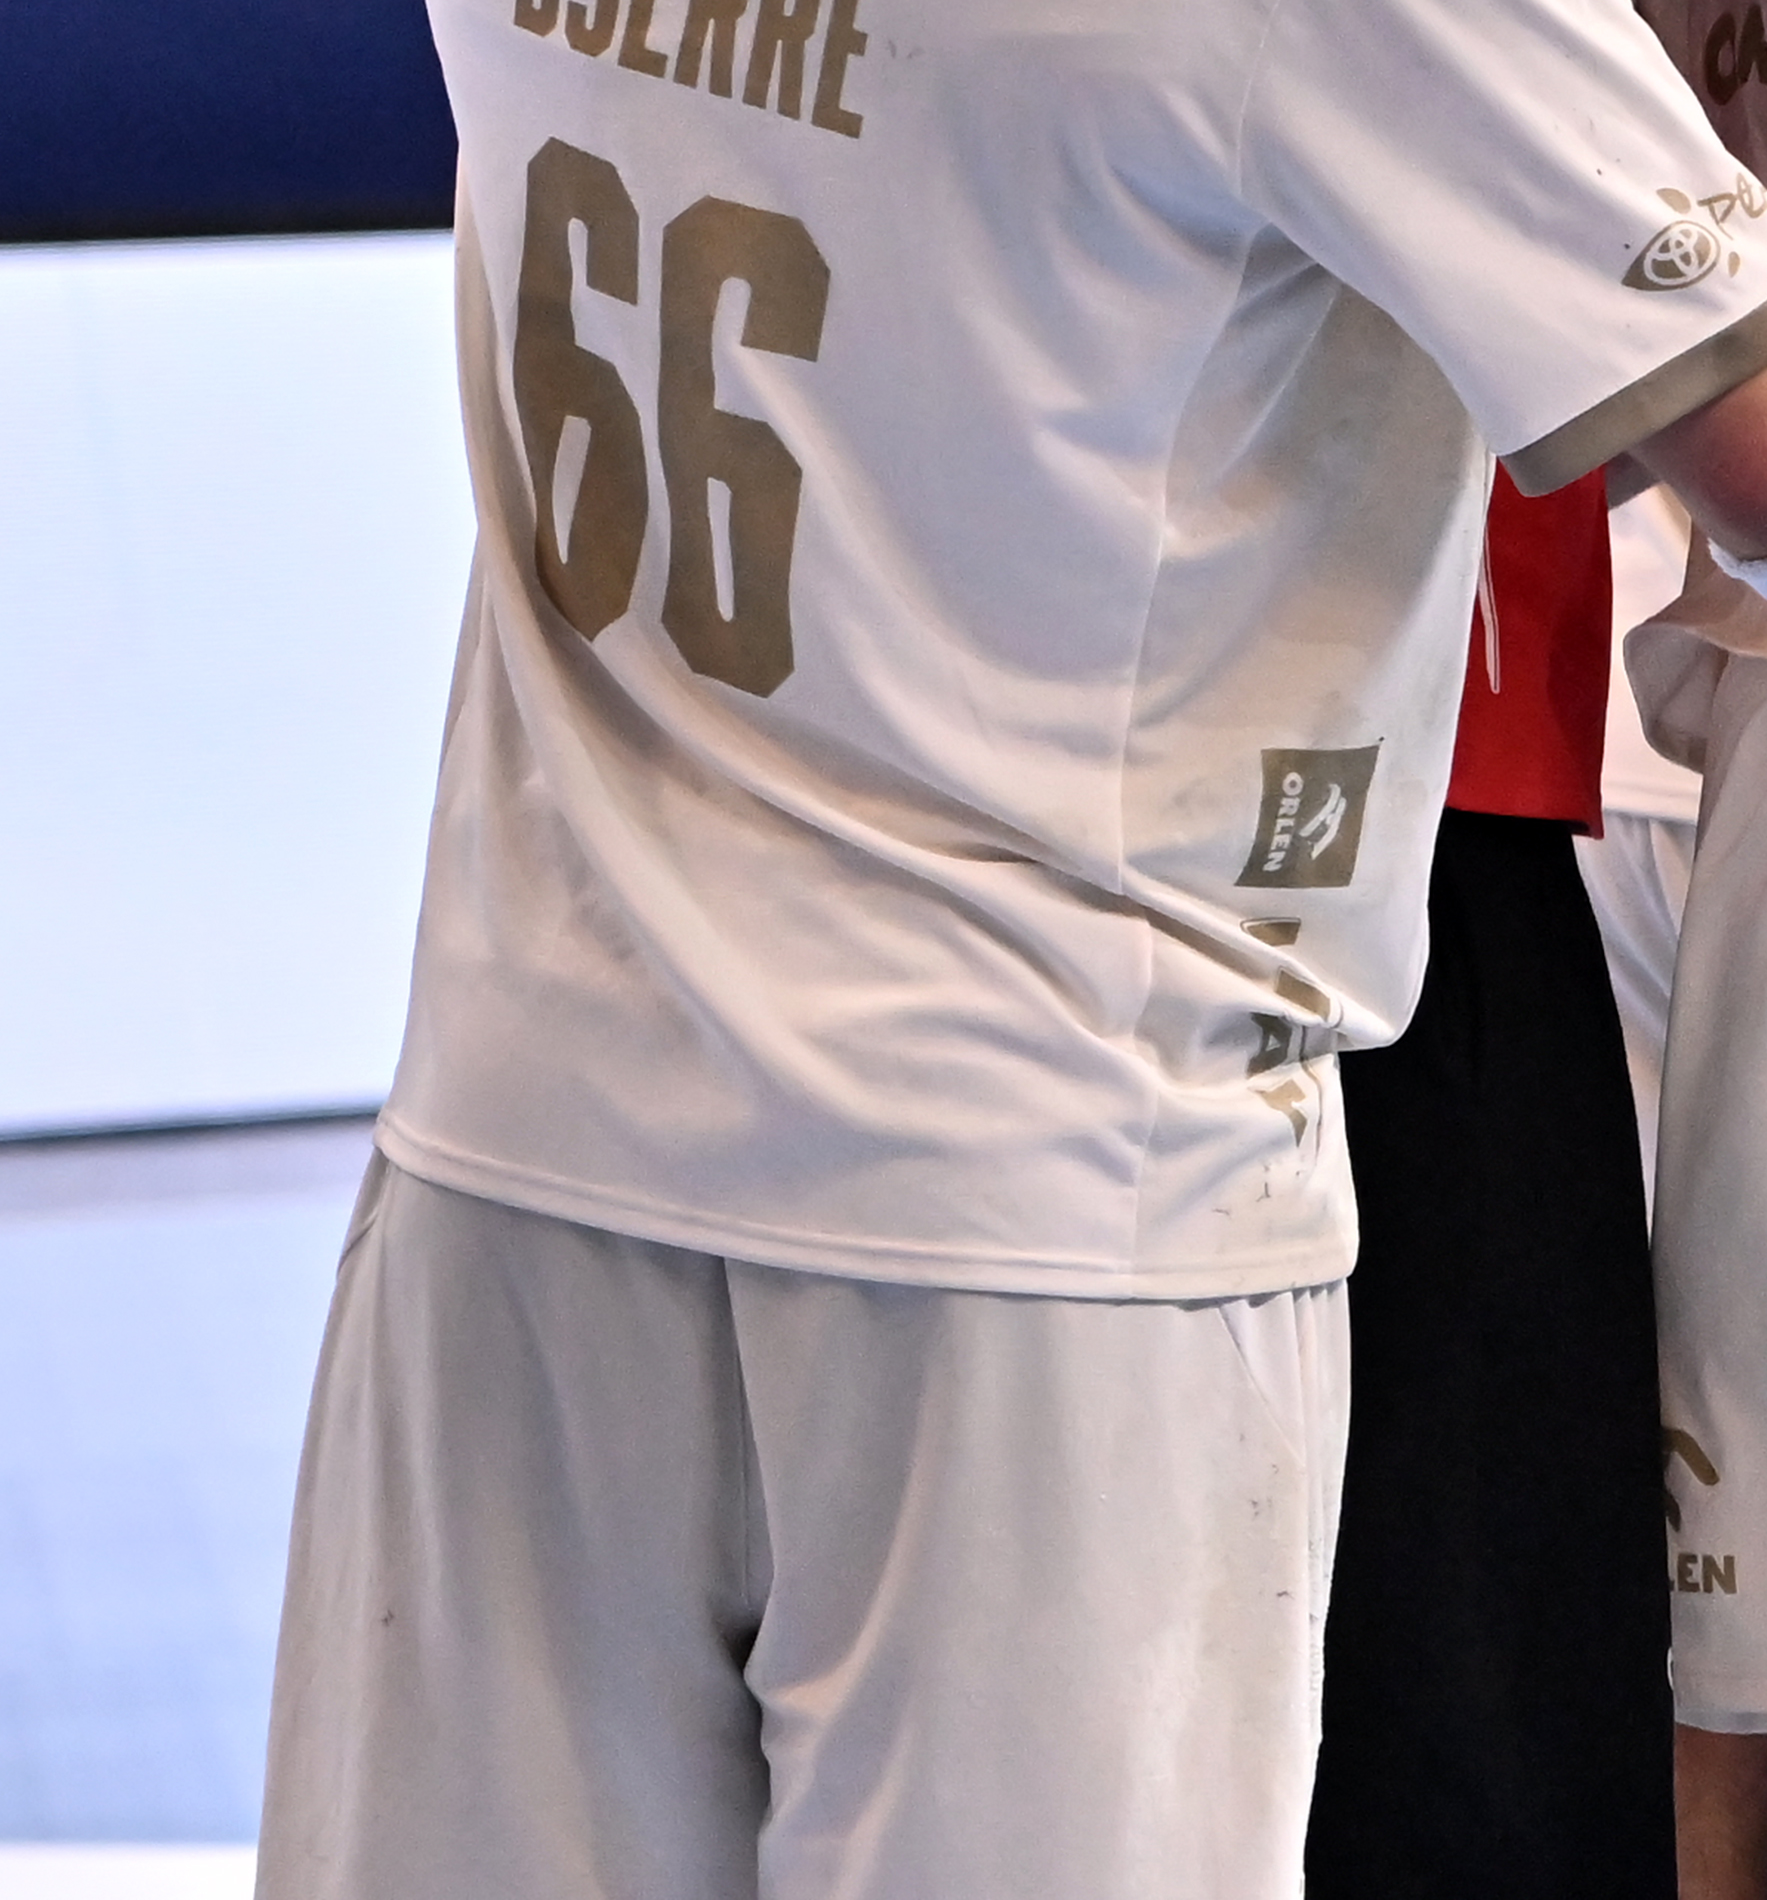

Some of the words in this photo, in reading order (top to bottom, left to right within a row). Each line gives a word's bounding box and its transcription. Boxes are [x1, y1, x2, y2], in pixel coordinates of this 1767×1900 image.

[513, 136, 831, 699] 66
[1262, 771, 1305, 873] ORLEN
[1668, 1552, 1737, 1594] EN
